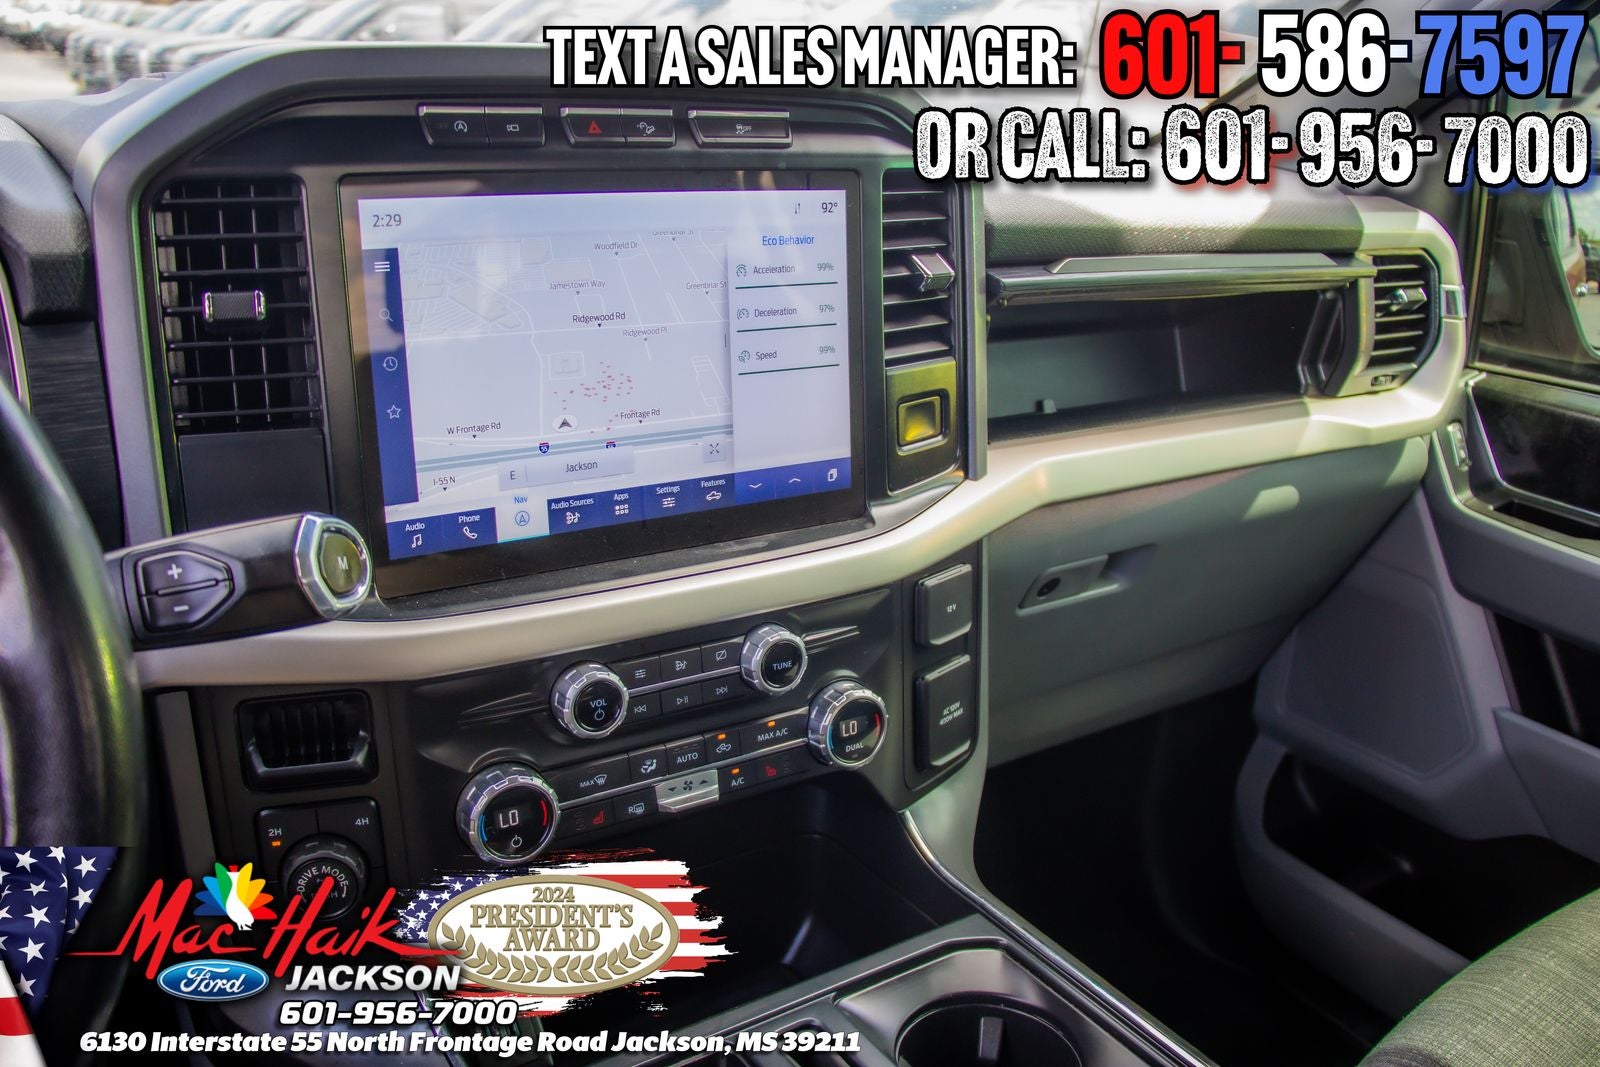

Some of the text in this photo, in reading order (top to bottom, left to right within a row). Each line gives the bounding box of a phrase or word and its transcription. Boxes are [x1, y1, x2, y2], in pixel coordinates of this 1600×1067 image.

[821, 202, 838, 214] 92°
[372, 213, 402, 228] 2:29
[594, 241, 638, 251] Woodfield Dr
[762, 235, 815, 246] Eco Behavior
[753, 262, 834, 275] Acceleration 99%
[549, 280, 606, 290] Jamestown Way
[686, 280, 718, 290] Greenbriar
[754, 304, 835, 318] Deceleration 97%
[572, 311, 626, 324] Ridgewood Rd
[622, 327, 659, 338] Ridgewood
[756, 345, 836, 362] Speed 99%
[620, 408, 661, 420] Frontage Rd
[456, 423, 489, 435] Frontage
[490, 421, 501, 430] Rd
[565, 460, 598, 473] Jackson
[510, 470, 516, 480] E
[433, 476, 456, 487] I-55 N
[700, 478, 726, 488] Features
[656, 484, 681, 496] Settings
[514, 495, 528, 505] Nav
[614, 492, 630, 502] Apps
[550, 496, 595, 510] Audio Sources
[458, 512, 481, 524] Phone
[405, 521, 426, 532] Audio
[772, 660, 793, 670] TUNE
[590, 698, 608, 708] VOL
[840, 720, 859, 737] LO
[757, 727, 789, 742] MAX A/C
[845, 742, 865, 752] DUAL
[676, 752, 699, 764] AUTO
[579, 778, 595, 789] MAX
[731, 776, 746, 787] A/C
[355, 817, 370, 826] 4H
[499, 809, 520, 829] LO
[268, 828, 282, 837] 2H
[296, 865, 349, 893] DRIVE MODE
